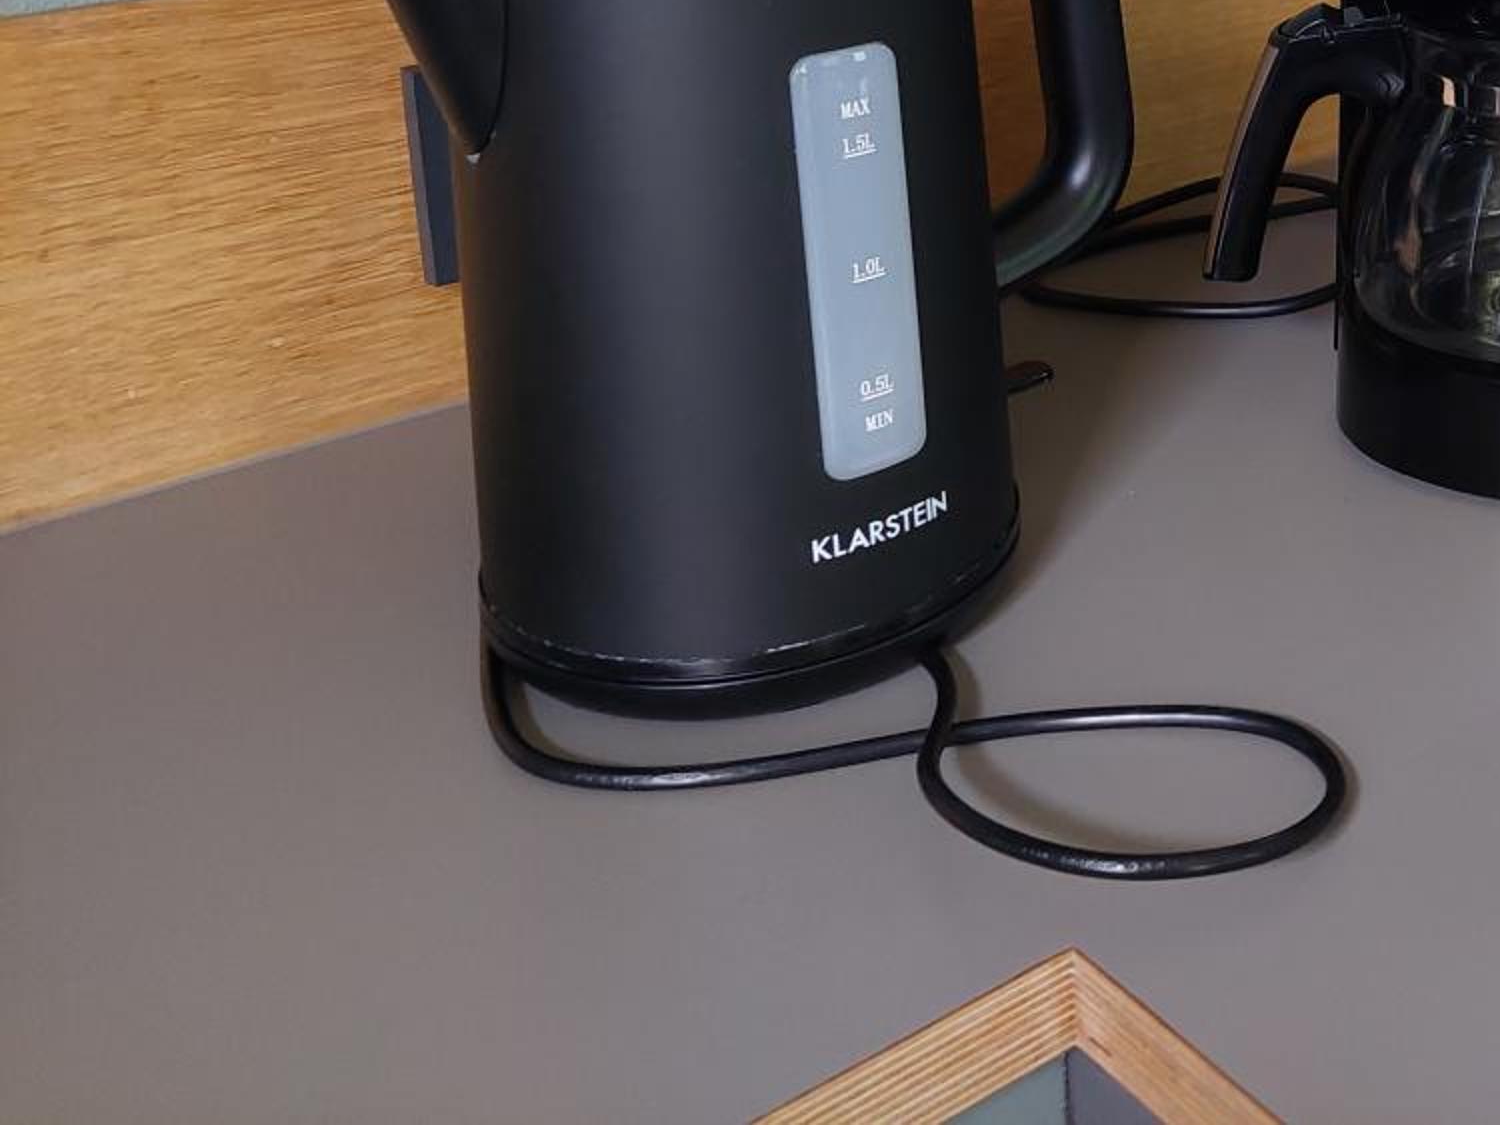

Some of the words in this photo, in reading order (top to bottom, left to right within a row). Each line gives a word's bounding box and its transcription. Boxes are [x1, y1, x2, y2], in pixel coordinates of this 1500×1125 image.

[840, 97, 871, 119] MAX
[842, 133, 875, 154] 1.5L
[852, 256, 885, 279] 1.0L
[860, 373, 894, 396] 0.5L
[864, 409, 895, 432] MIN
[811, 490, 948, 564] KLARSTEIN
